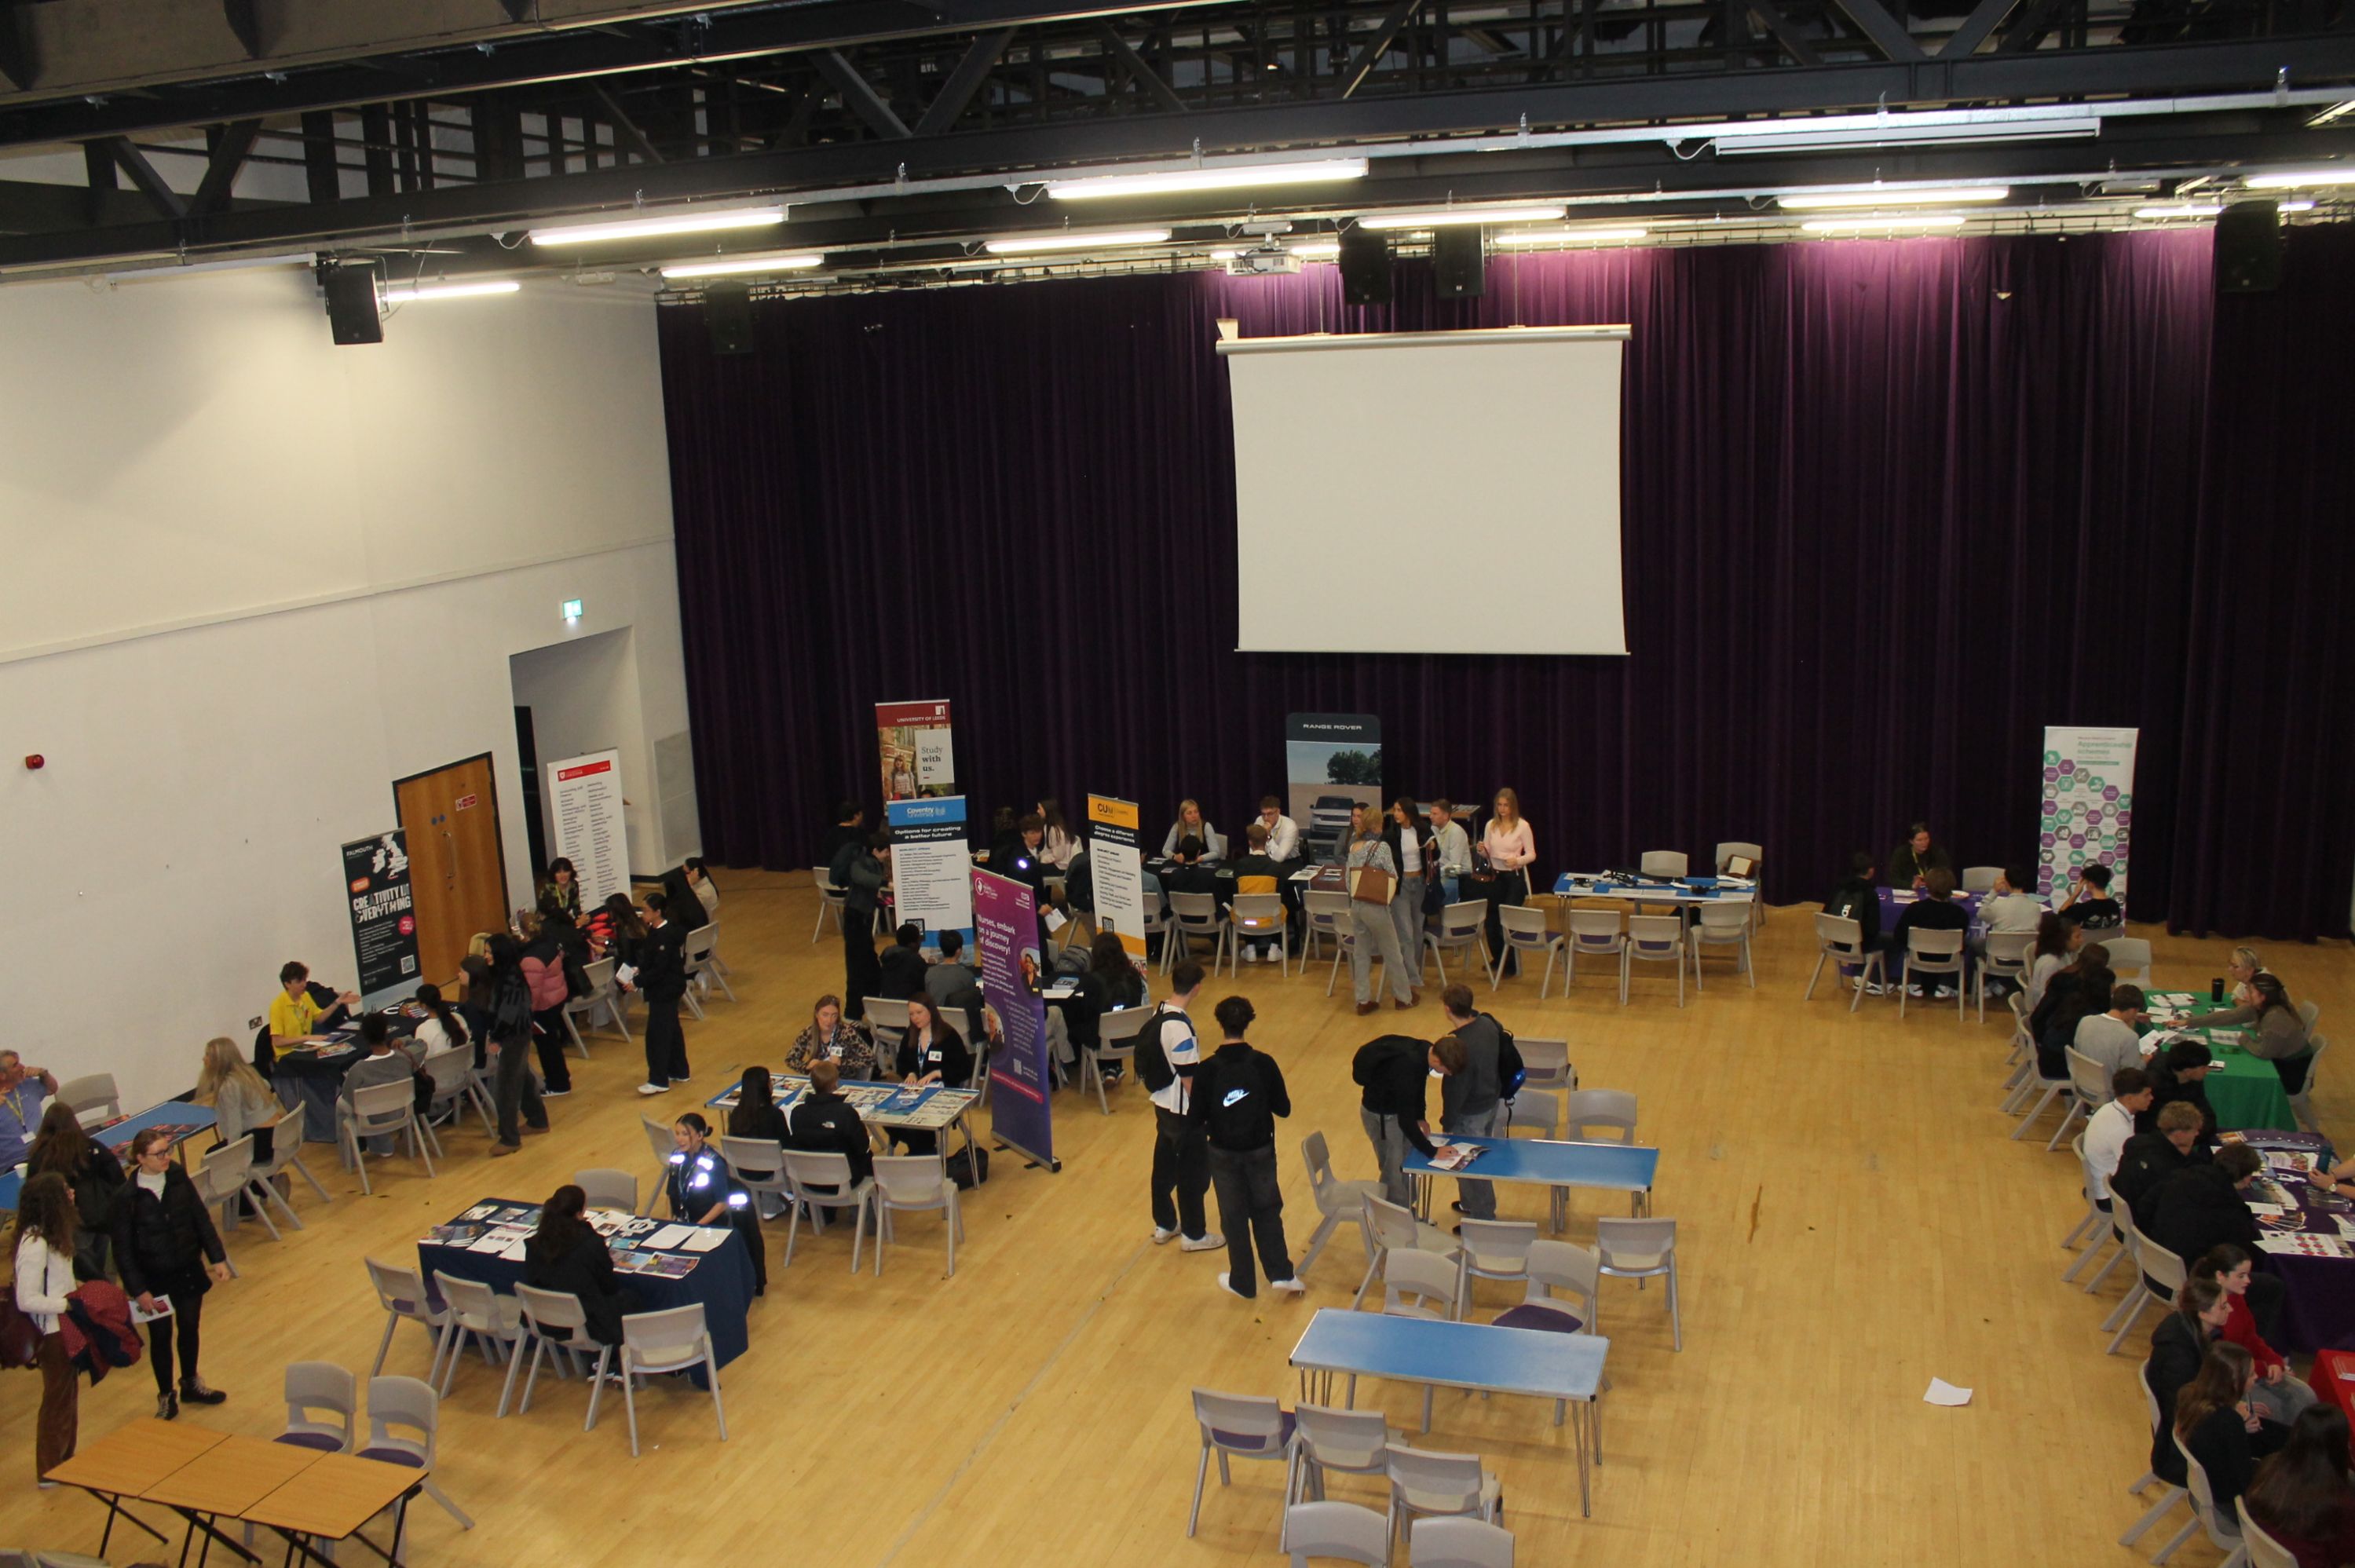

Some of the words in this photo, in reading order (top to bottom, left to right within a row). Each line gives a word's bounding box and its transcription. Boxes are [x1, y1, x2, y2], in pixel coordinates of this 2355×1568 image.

[921, 746, 943, 755] Study
[346, 845, 373, 857] FALMOUTH
[353, 886, 399, 911] CREATIVITY
[400, 883, 409, 897] IN
[355, 896, 411, 923] EVERYTHING
[977, 914, 996, 928] Nurses,
[996, 922, 1015, 935] embark
[990, 929, 1010, 945] journey
[985, 938, 1011, 955] discovery!
